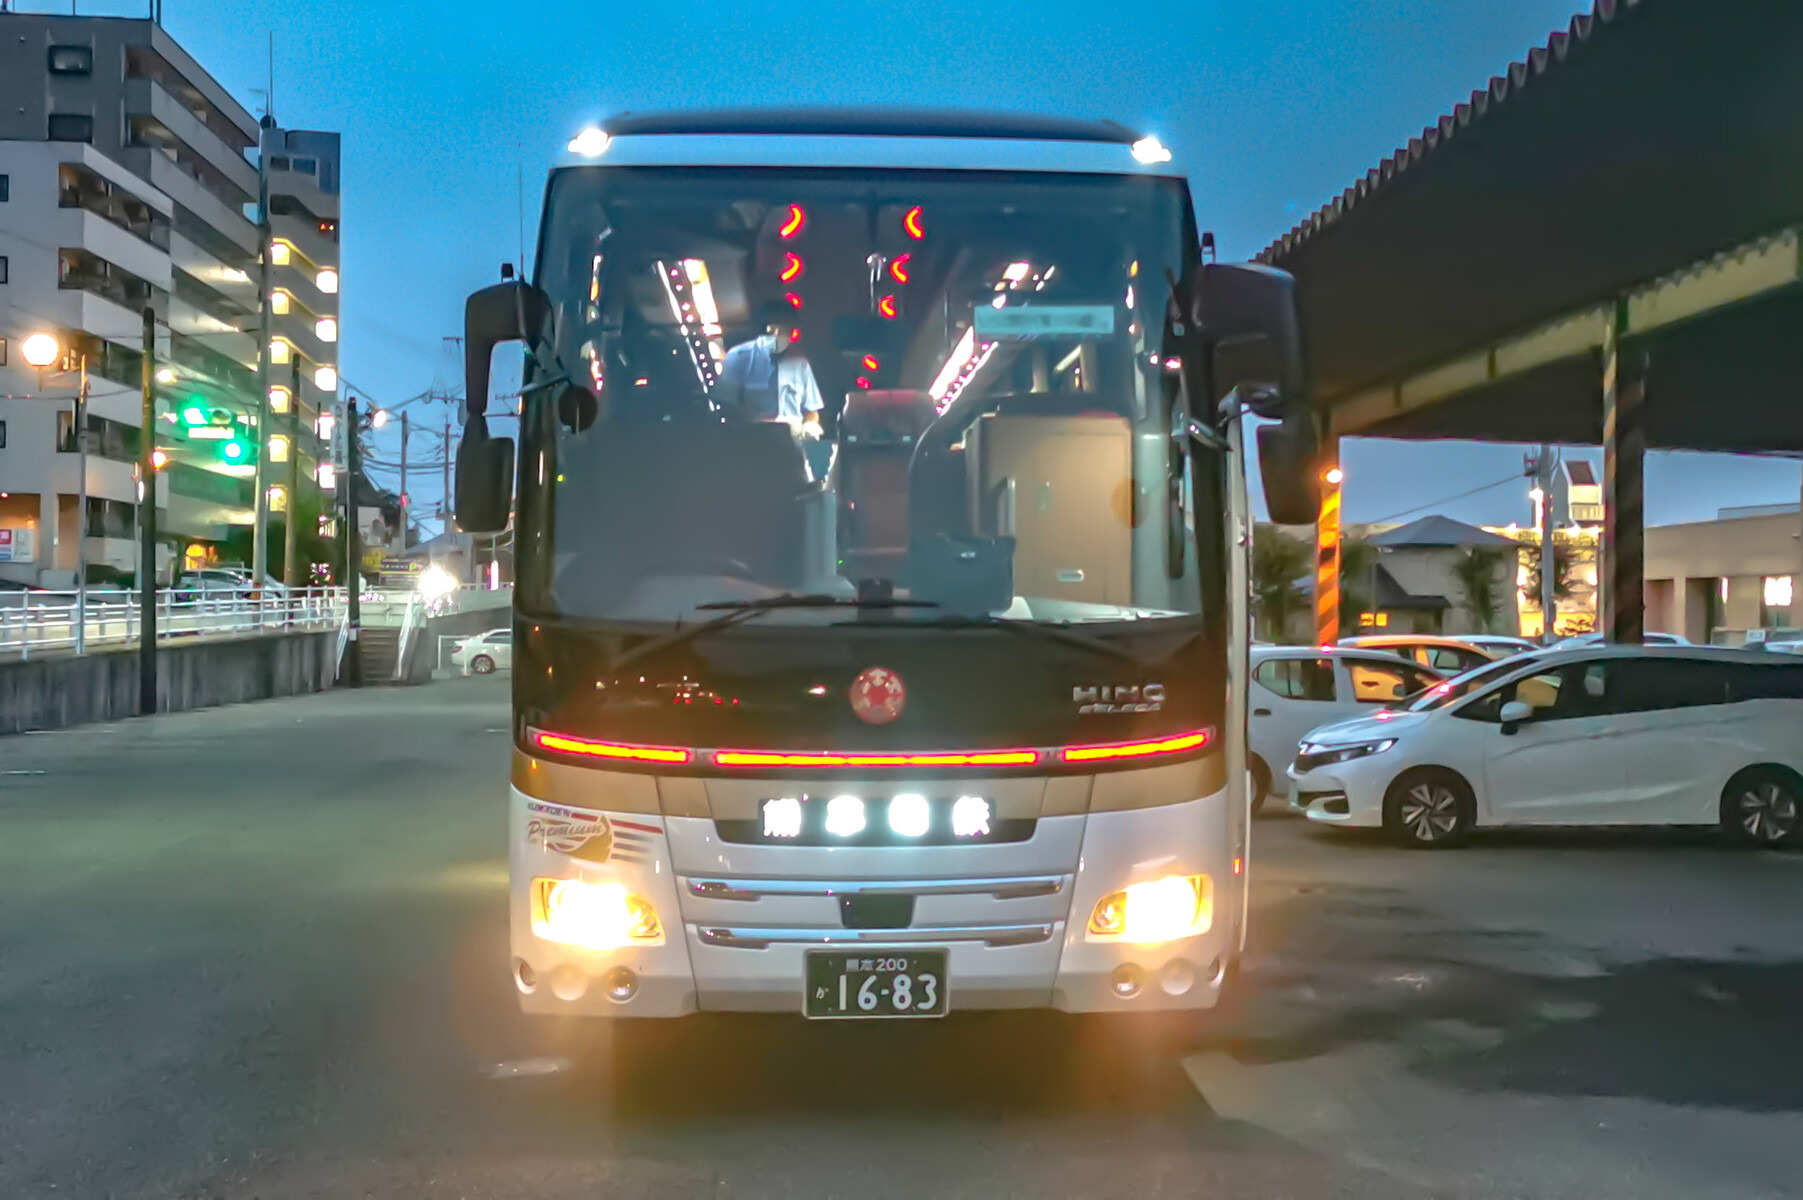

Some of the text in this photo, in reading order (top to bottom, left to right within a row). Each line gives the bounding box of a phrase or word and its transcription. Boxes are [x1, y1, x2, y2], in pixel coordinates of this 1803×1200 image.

[1072, 684, 1165, 701] HINO
[875, 958, 908, 972] 200
[838, 973, 938, 1011] 16-83
